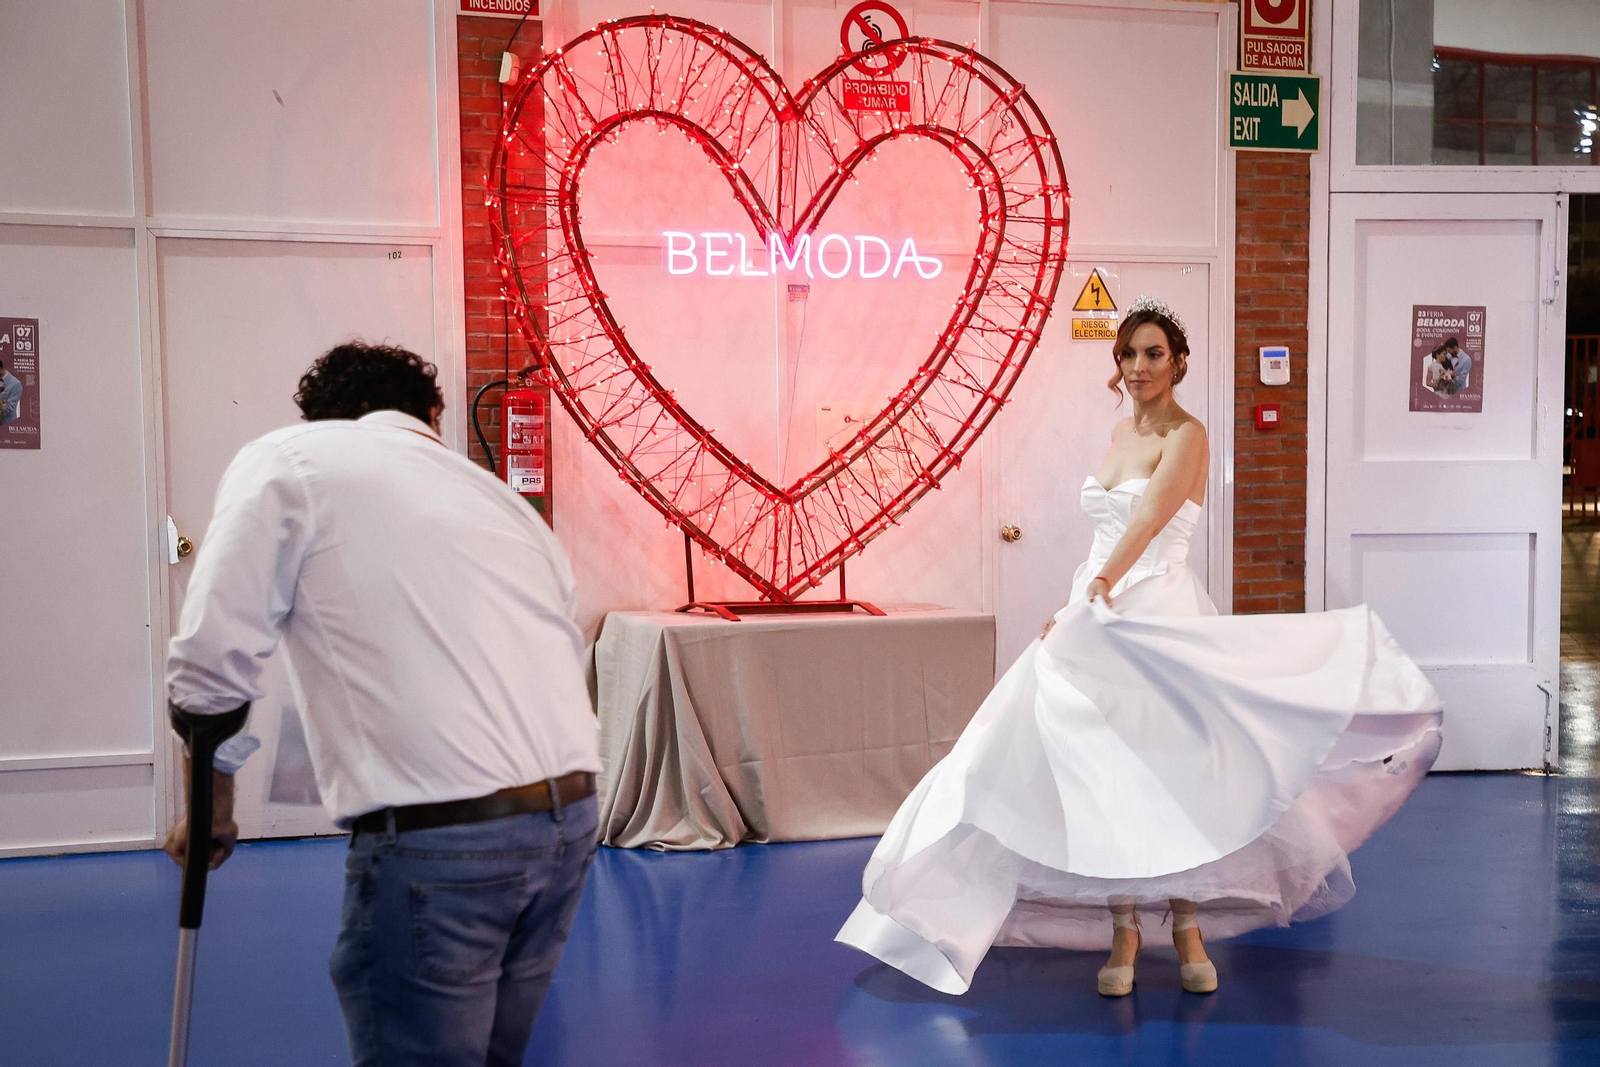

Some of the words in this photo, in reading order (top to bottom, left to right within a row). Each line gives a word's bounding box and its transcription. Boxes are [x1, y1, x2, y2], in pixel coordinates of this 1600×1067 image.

[469, 0, 531, 12] INCENDIOS
[1247, 41, 1302, 55] PULSADOR
[1245, 54, 1259, 65] DE
[1261, 55, 1304, 68] ALARMA
[1233, 81, 1279, 107] SALIDA
[859, 96, 896, 109] UMAR
[1233, 116, 1261, 141] EXIT
[388, 251, 402, 260] 102
[661, 231, 943, 279] BELMODA
[1416, 318, 1465, 327] BELMODA
[1469, 313, 1481, 322] 07
[1081, 320, 1109, 329] RIESGO
[1468, 325, 1481, 333] 09
[16, 327, 31, 337] 07
[1074, 329, 1116, 338] ELECTRICO
[16, 340, 32, 351] 09
